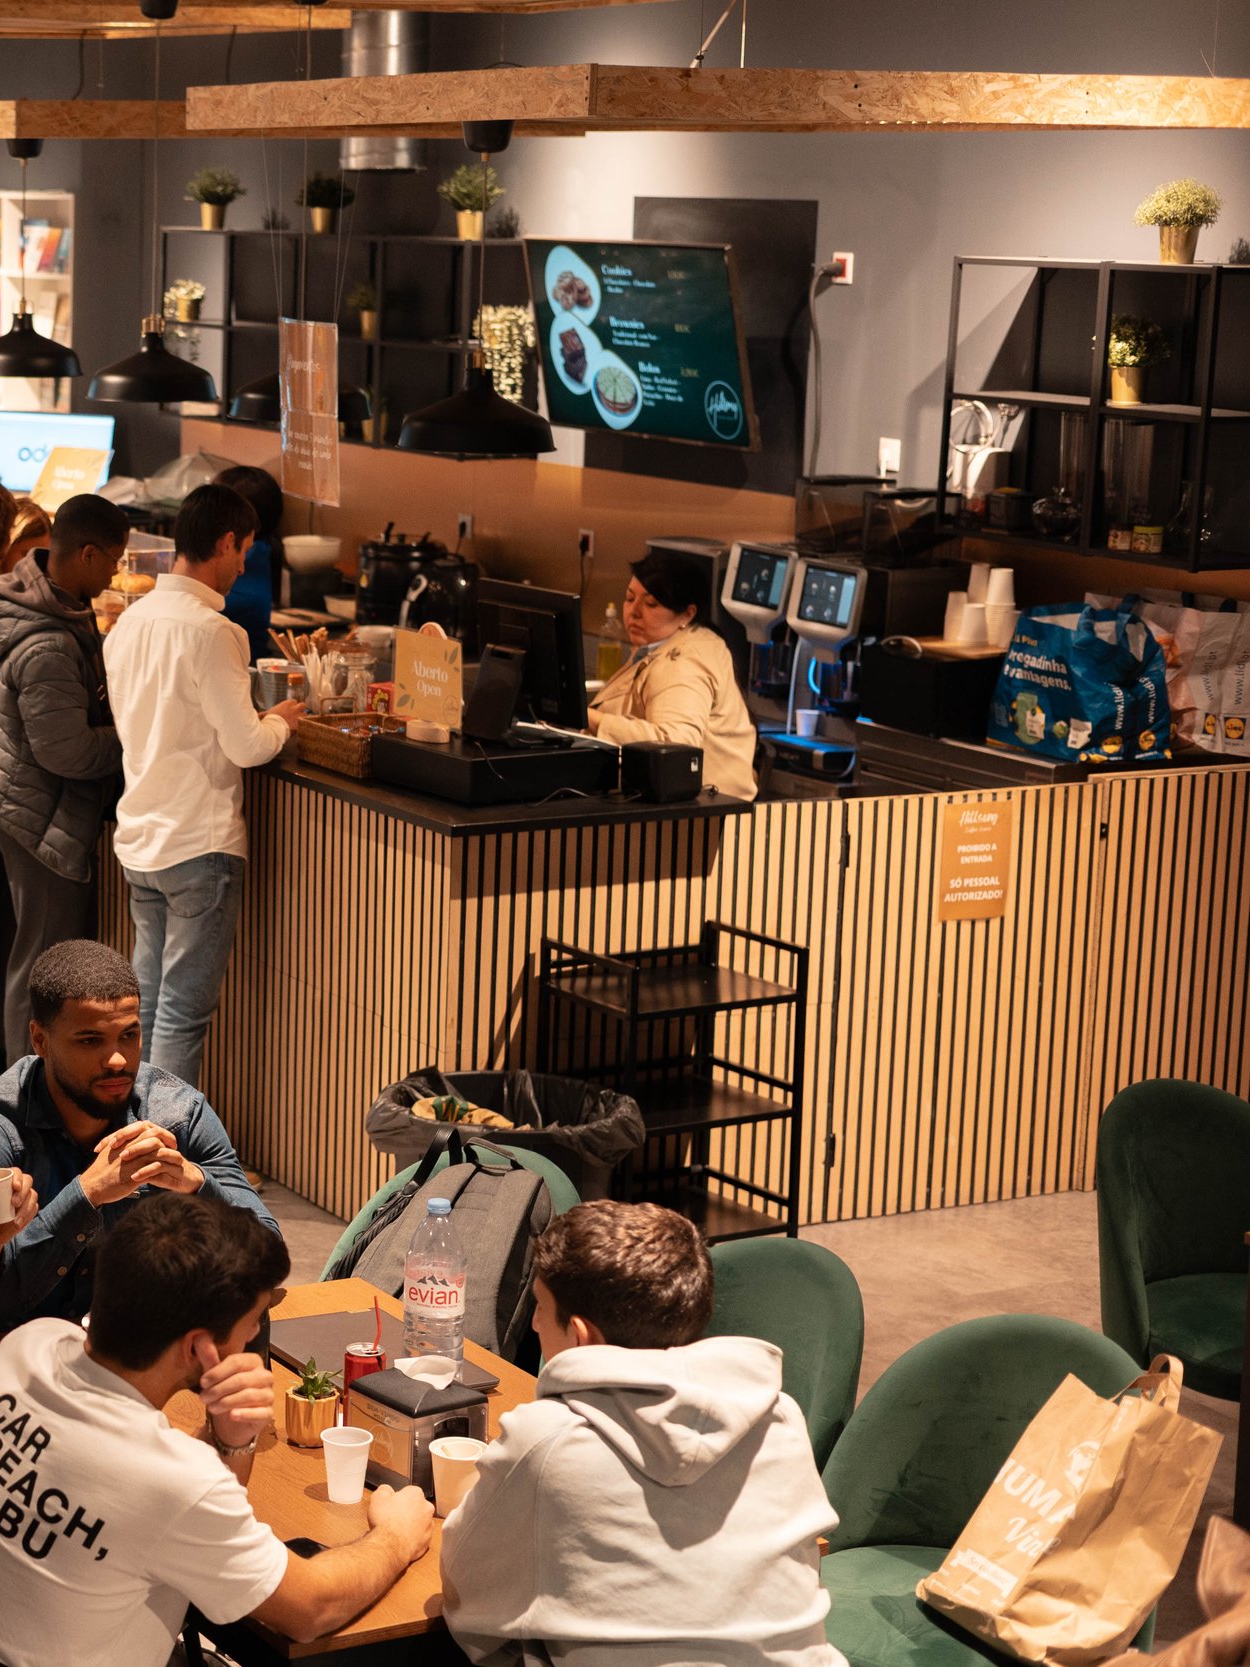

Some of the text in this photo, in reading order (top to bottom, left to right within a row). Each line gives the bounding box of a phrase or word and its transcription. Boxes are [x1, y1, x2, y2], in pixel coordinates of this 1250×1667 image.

[601, 263, 633, 277] Cookies
[609, 316, 645, 330] Brownies
[414, 660, 448, 683] Aberto
[417, 679, 441, 697] Open
[957, 842, 998, 853] PROIBIDO A
[960, 854, 993, 865] ENTRADA
[949, 875, 1000, 889] SÓ PESSOAL
[944, 890, 1004, 903] AUTORIZADO!
[408, 1286, 459, 1305] evian
